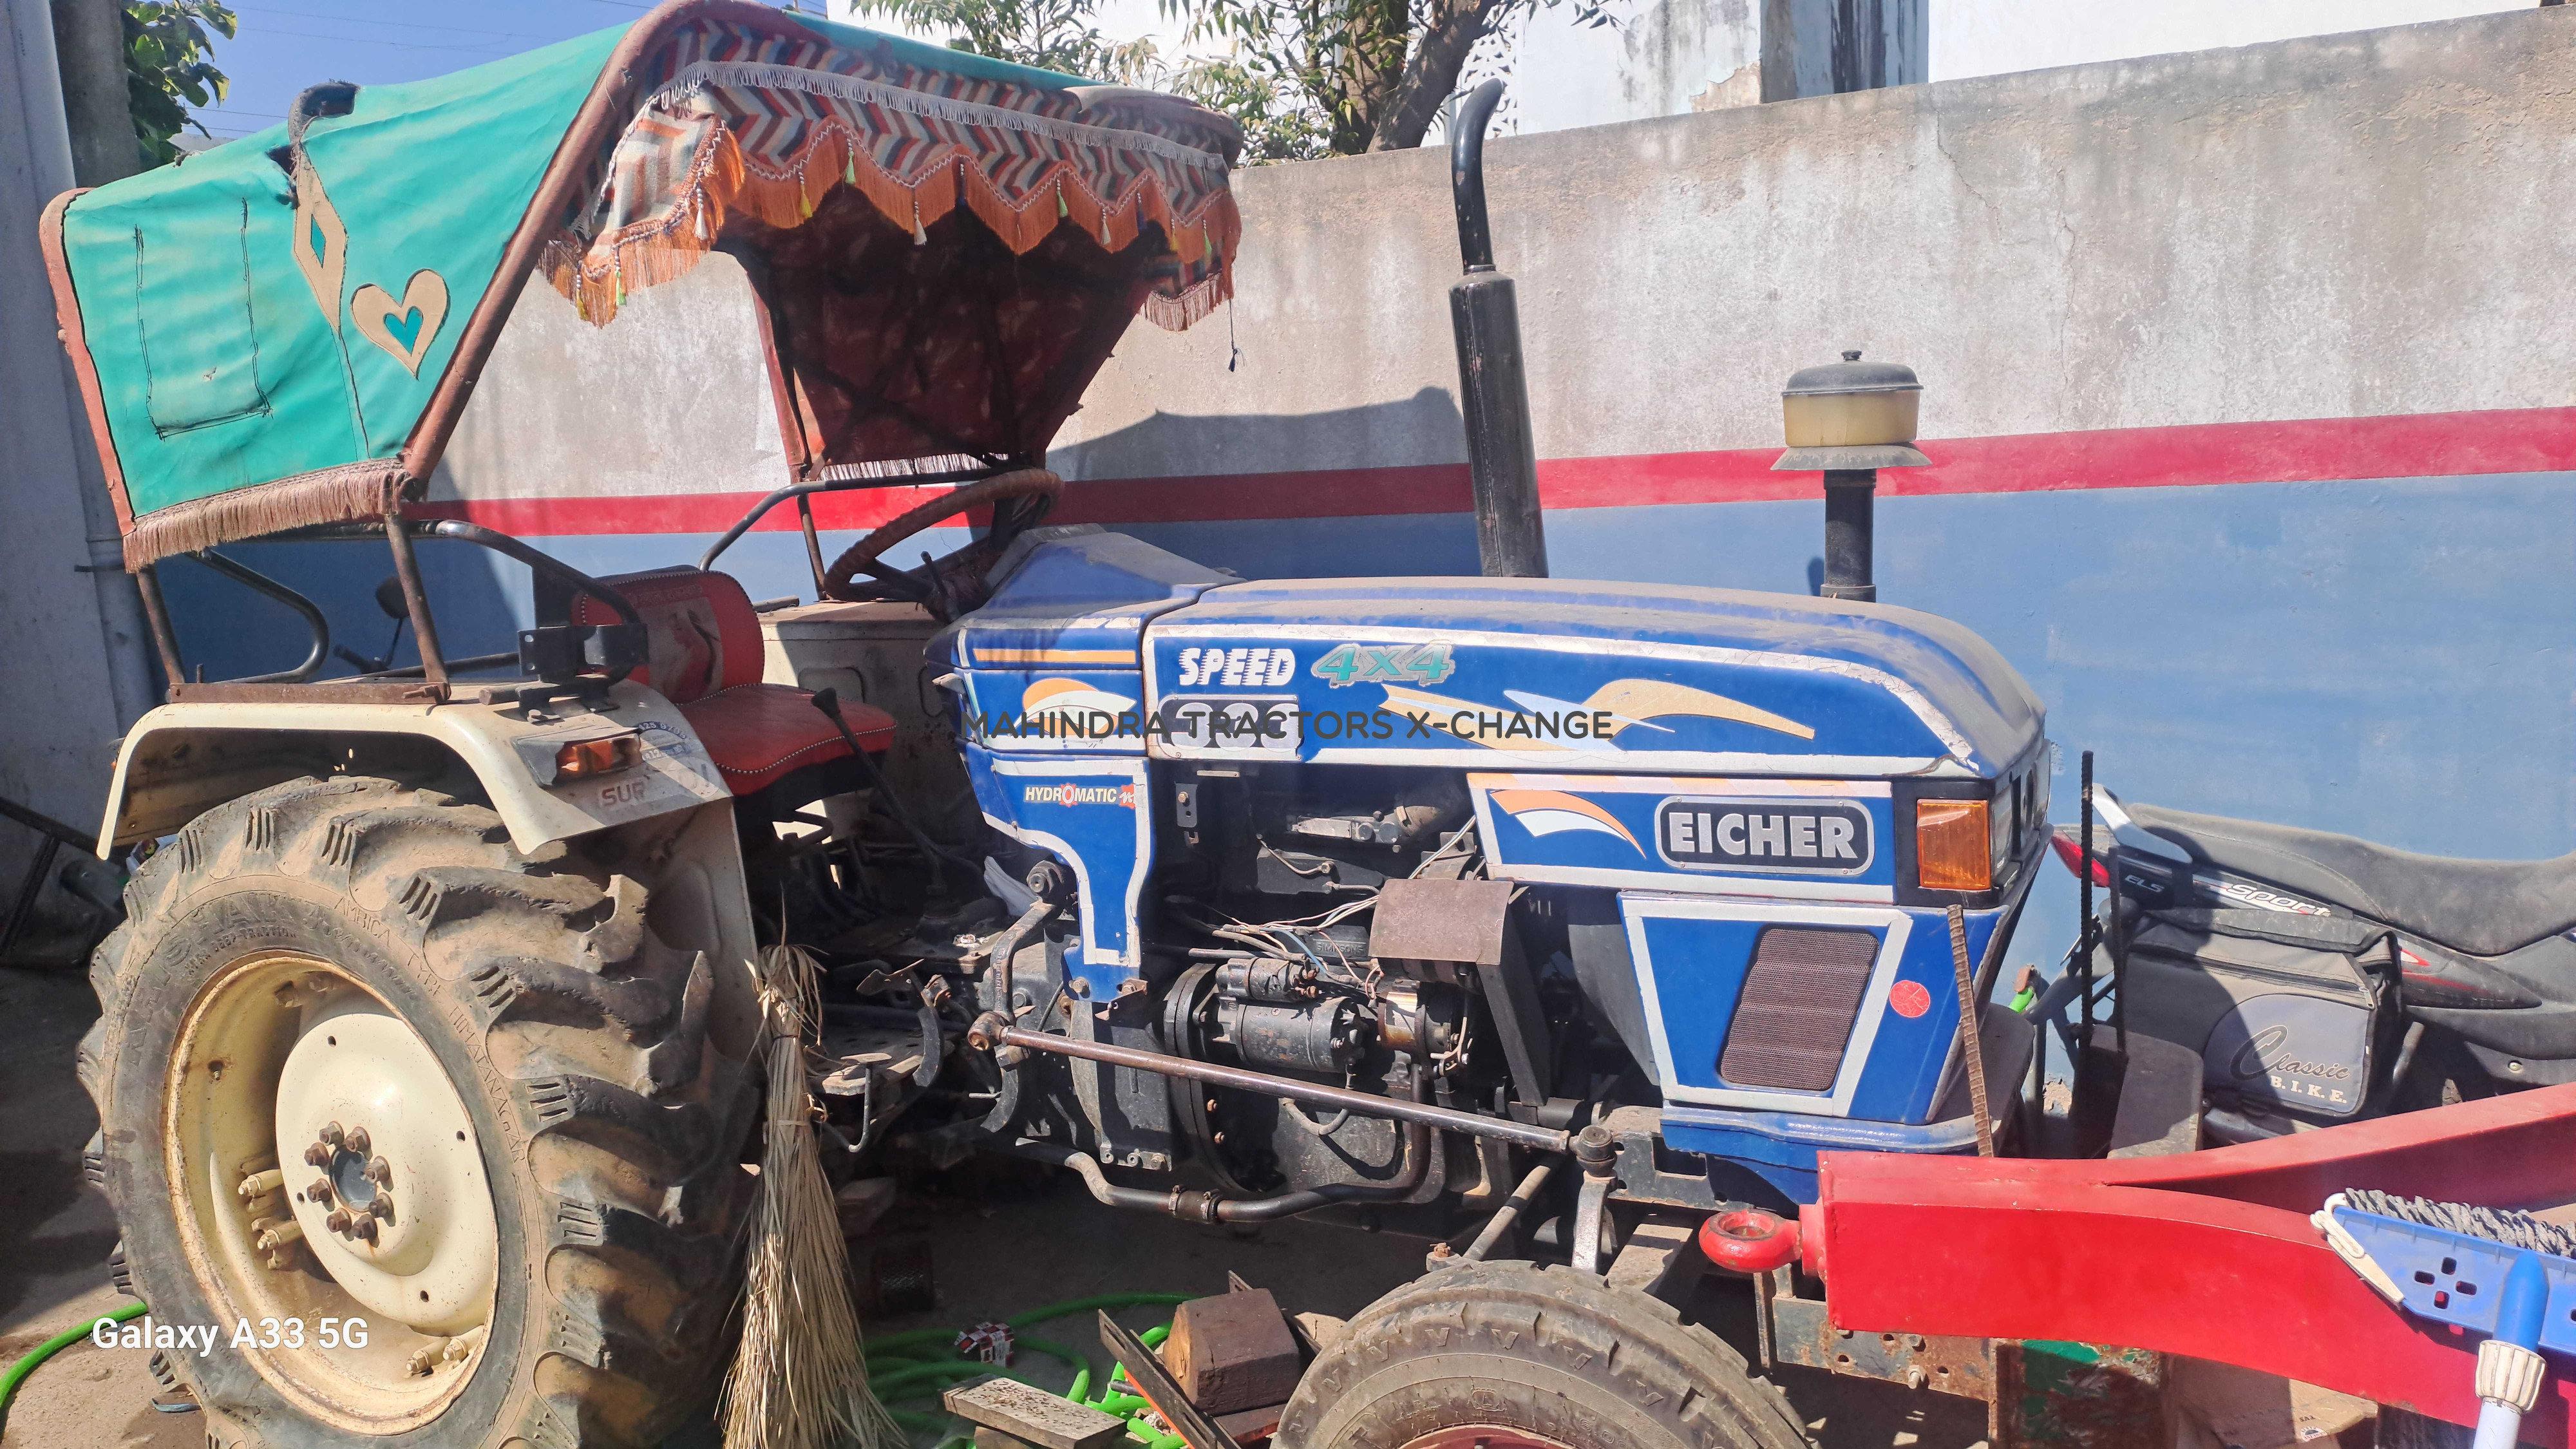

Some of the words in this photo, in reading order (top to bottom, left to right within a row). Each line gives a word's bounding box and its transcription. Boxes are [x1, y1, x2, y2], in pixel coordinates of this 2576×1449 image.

[1179, 648, 1296, 685] SPEED
[1025, 785, 1117, 804] HYDROMATIC
[1669, 812, 1858, 858] EICHER
[334, 896, 390, 947] AMBICA
[2230, 1025, 2349, 1081] Classic
